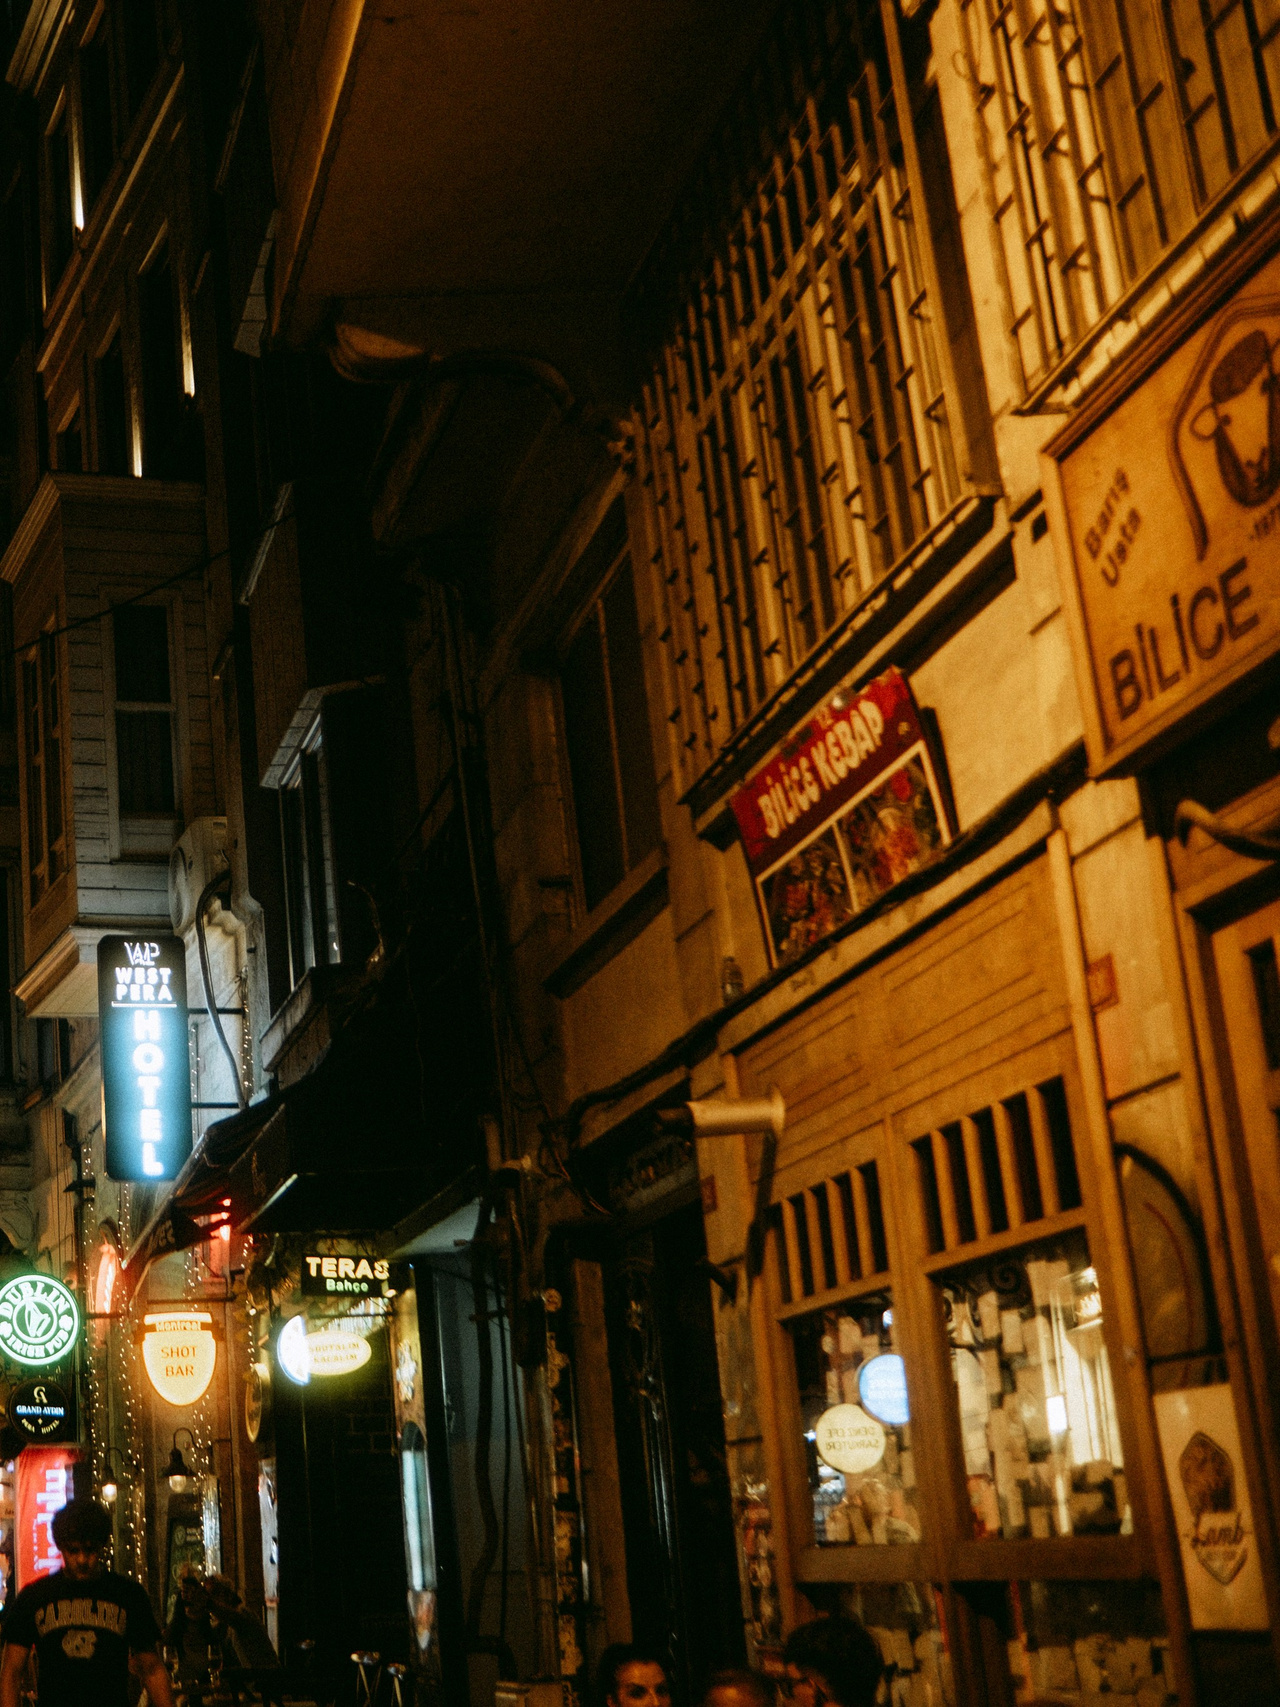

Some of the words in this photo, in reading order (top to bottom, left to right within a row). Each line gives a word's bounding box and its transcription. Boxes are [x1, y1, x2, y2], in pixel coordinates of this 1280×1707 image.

[115, 967, 172, 985] WEST
[116, 984, 173, 1001] PERA
[132, 1009, 164, 1177] HOTEL
[305, 1256, 390, 1280] TERAS
[6, 1336, 46, 1358] IRISH
[47, 1328, 70, 1356] PUB
[161, 1346, 198, 1359] SHOT
[165, 1364, 195, 1378] BAR
[16, 1404, 42, 1416] GRAND
